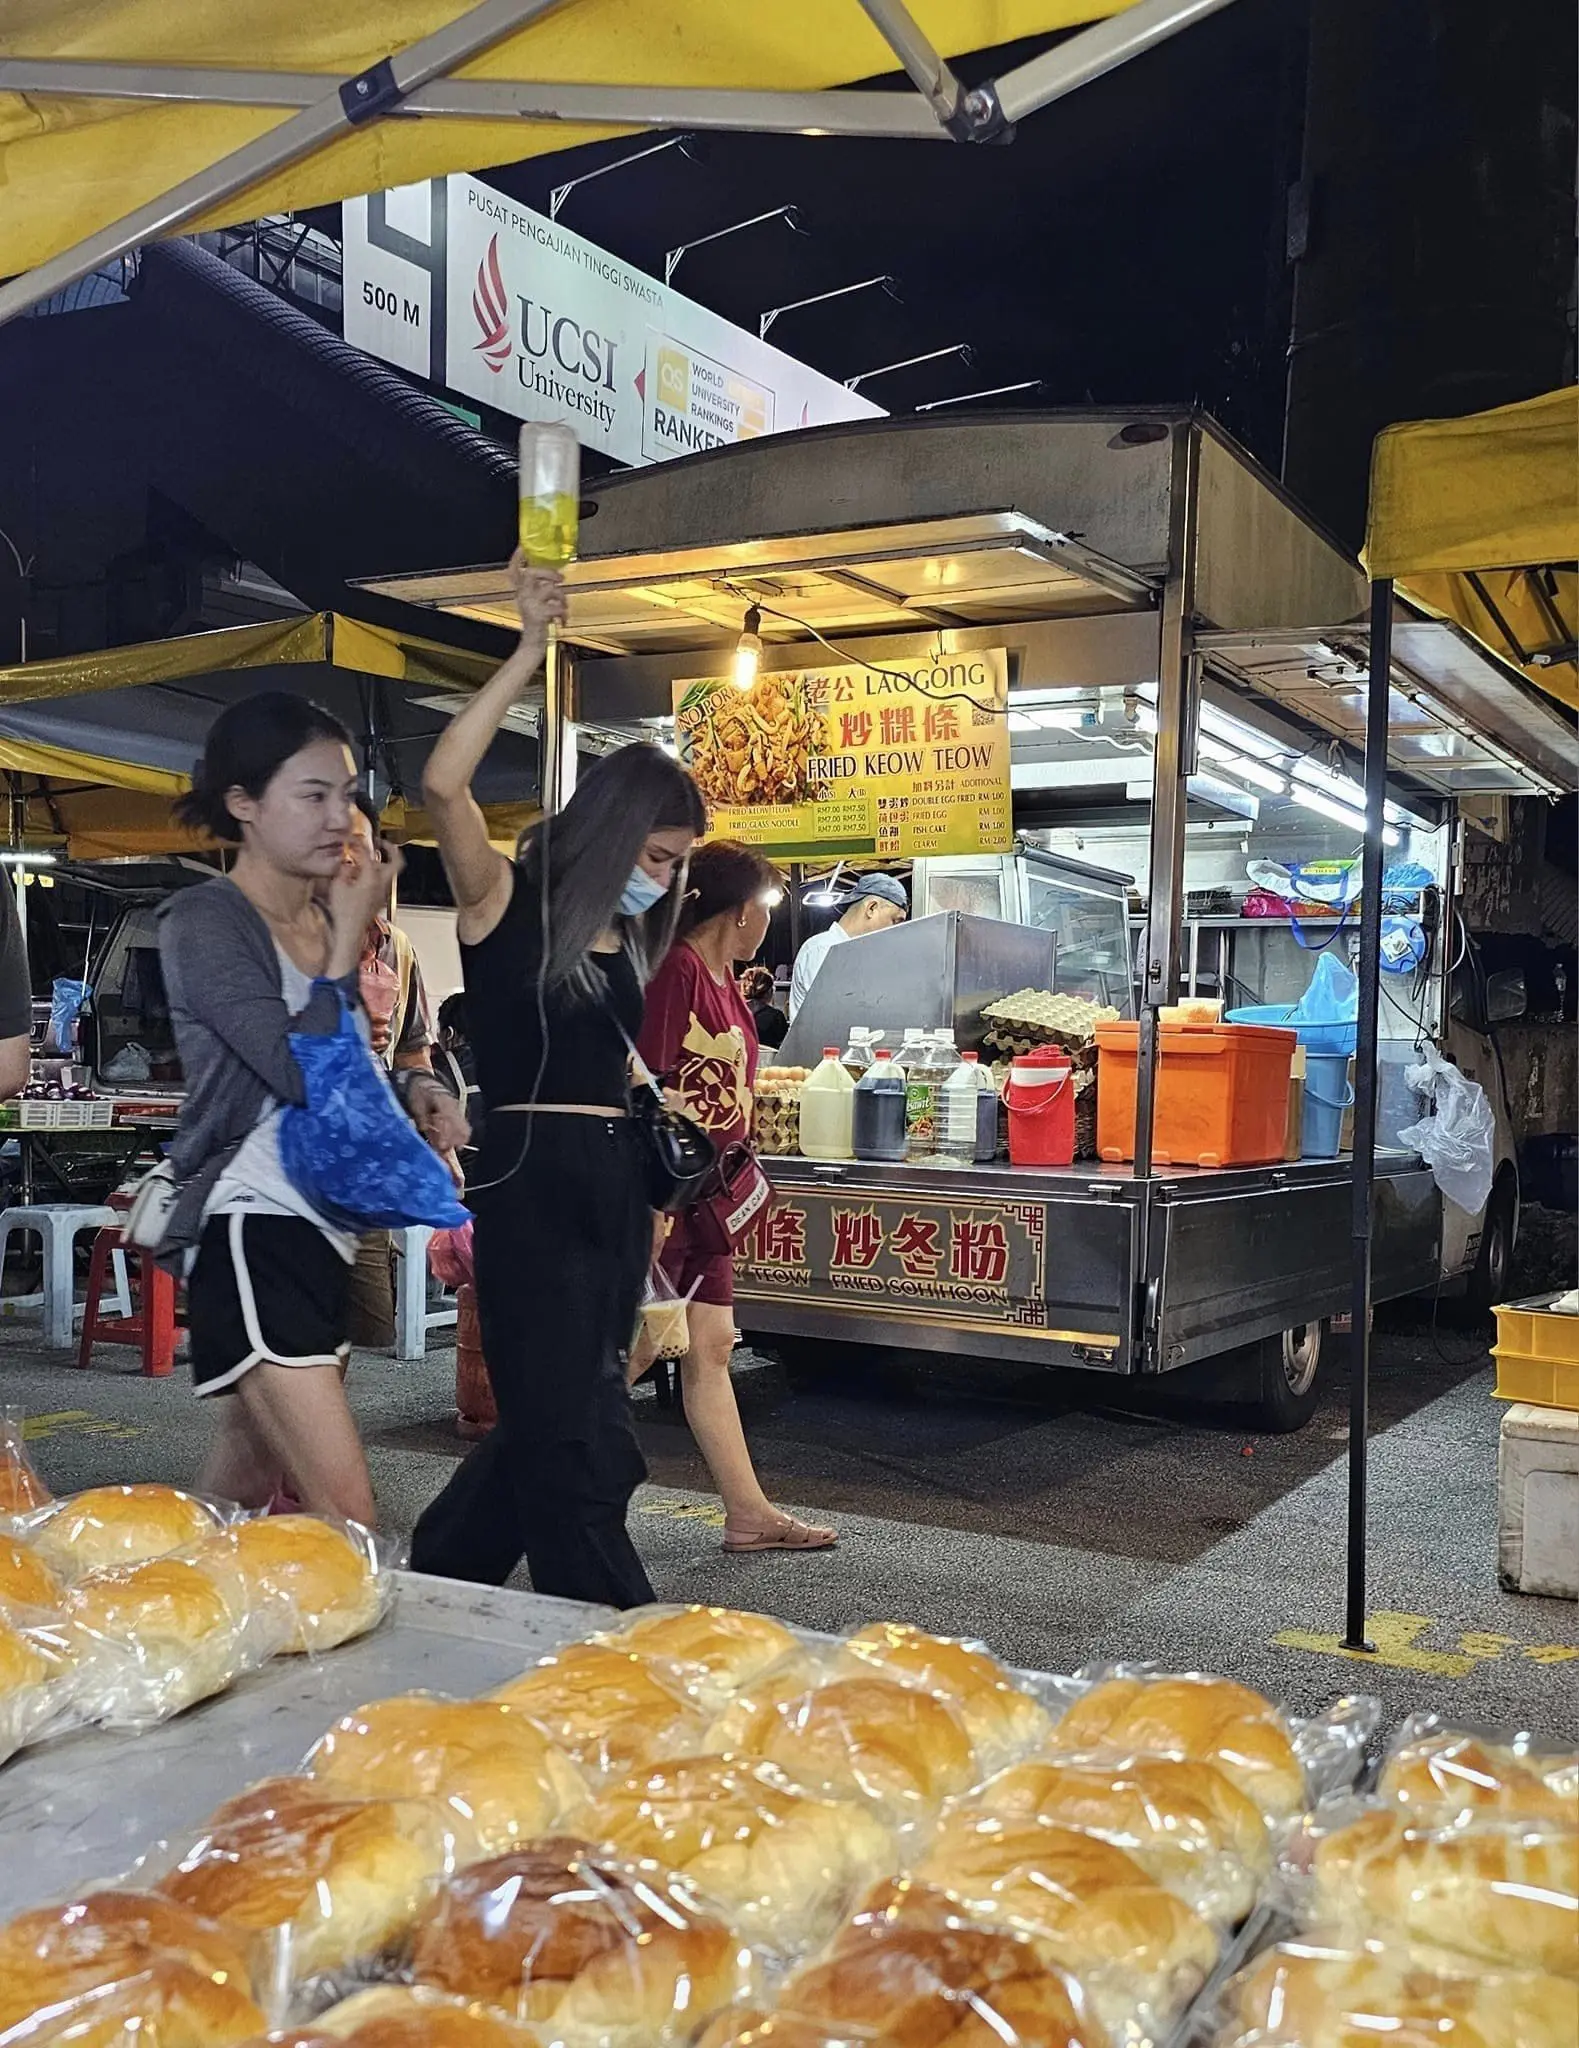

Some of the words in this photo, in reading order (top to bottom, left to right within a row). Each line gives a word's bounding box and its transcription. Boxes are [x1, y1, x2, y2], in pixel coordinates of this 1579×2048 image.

[468, 190, 508, 225] PUSAT
[511, 213, 581, 265] PENGAJIAN
[584, 253, 622, 286] TINGGI
[624, 276, 664, 309] SWASTA
[363, 281, 398, 316] 500
[404, 299, 420, 327] M
[517, 294, 618, 393] UCSI
[661, 363, 684, 394] QS
[692, 362, 724, 388] WORLD
[517, 354, 616, 433] University
[691, 383, 741, 416] UNIVERSITY
[691, 403, 735, 433] RANKINGS
[677, 706, 702, 731] NO
[839, 703, 960, 749] 炒粿條
[807, 756, 857, 780] FRIED
[865, 751, 924, 776] KEOW
[933, 745, 993, 771] TEOW
[960, 777, 1003, 788] ADDITIONAL
[912, 796, 939, 806] DOUBLE
[940, 795, 956, 804] EGG
[957, 794, 976, 803] FRIED
[912, 811, 930, 820] FRIED
[932, 810, 948, 819] EGG
[912, 826, 926, 834] FISH
[929, 824, 947, 833] CAKE
[830, 1208, 1009, 1282] 炒冬粉
[751, 1266, 811, 1286] TEOW
[831, 1274, 884, 1292] FRIED
